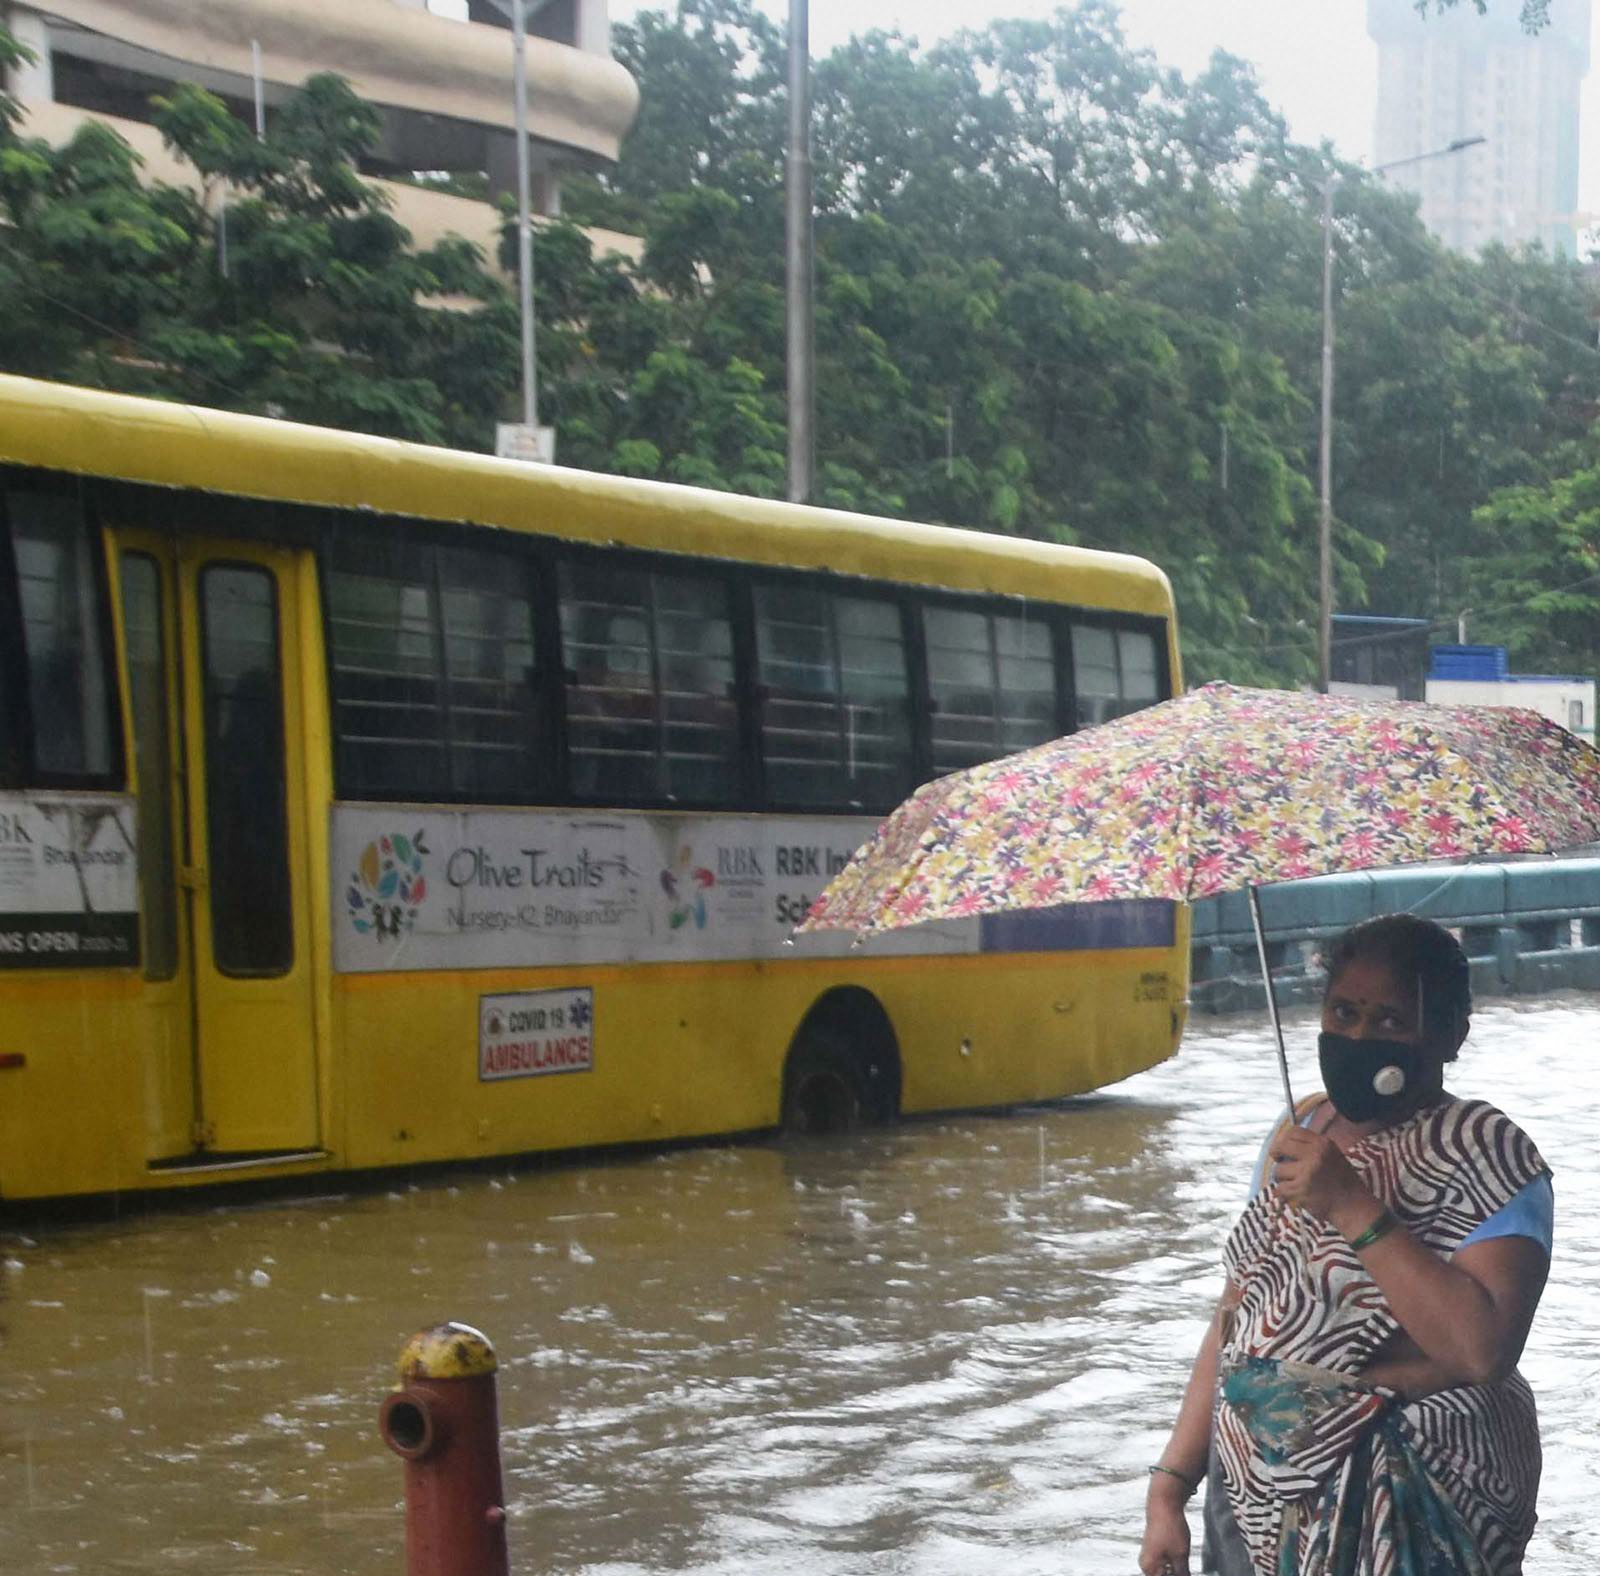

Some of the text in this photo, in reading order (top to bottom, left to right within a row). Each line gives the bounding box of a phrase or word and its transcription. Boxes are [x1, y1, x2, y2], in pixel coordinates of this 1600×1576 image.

[446, 847, 604, 888] Olive Traits
[718, 847, 764, 876] RBK
[776, 846, 819, 876] RBK
[26, 931, 79, 953] OPEN
[509, 1007, 563, 1034] COVID 19
[484, 1035, 589, 1073] AMBULANCE
